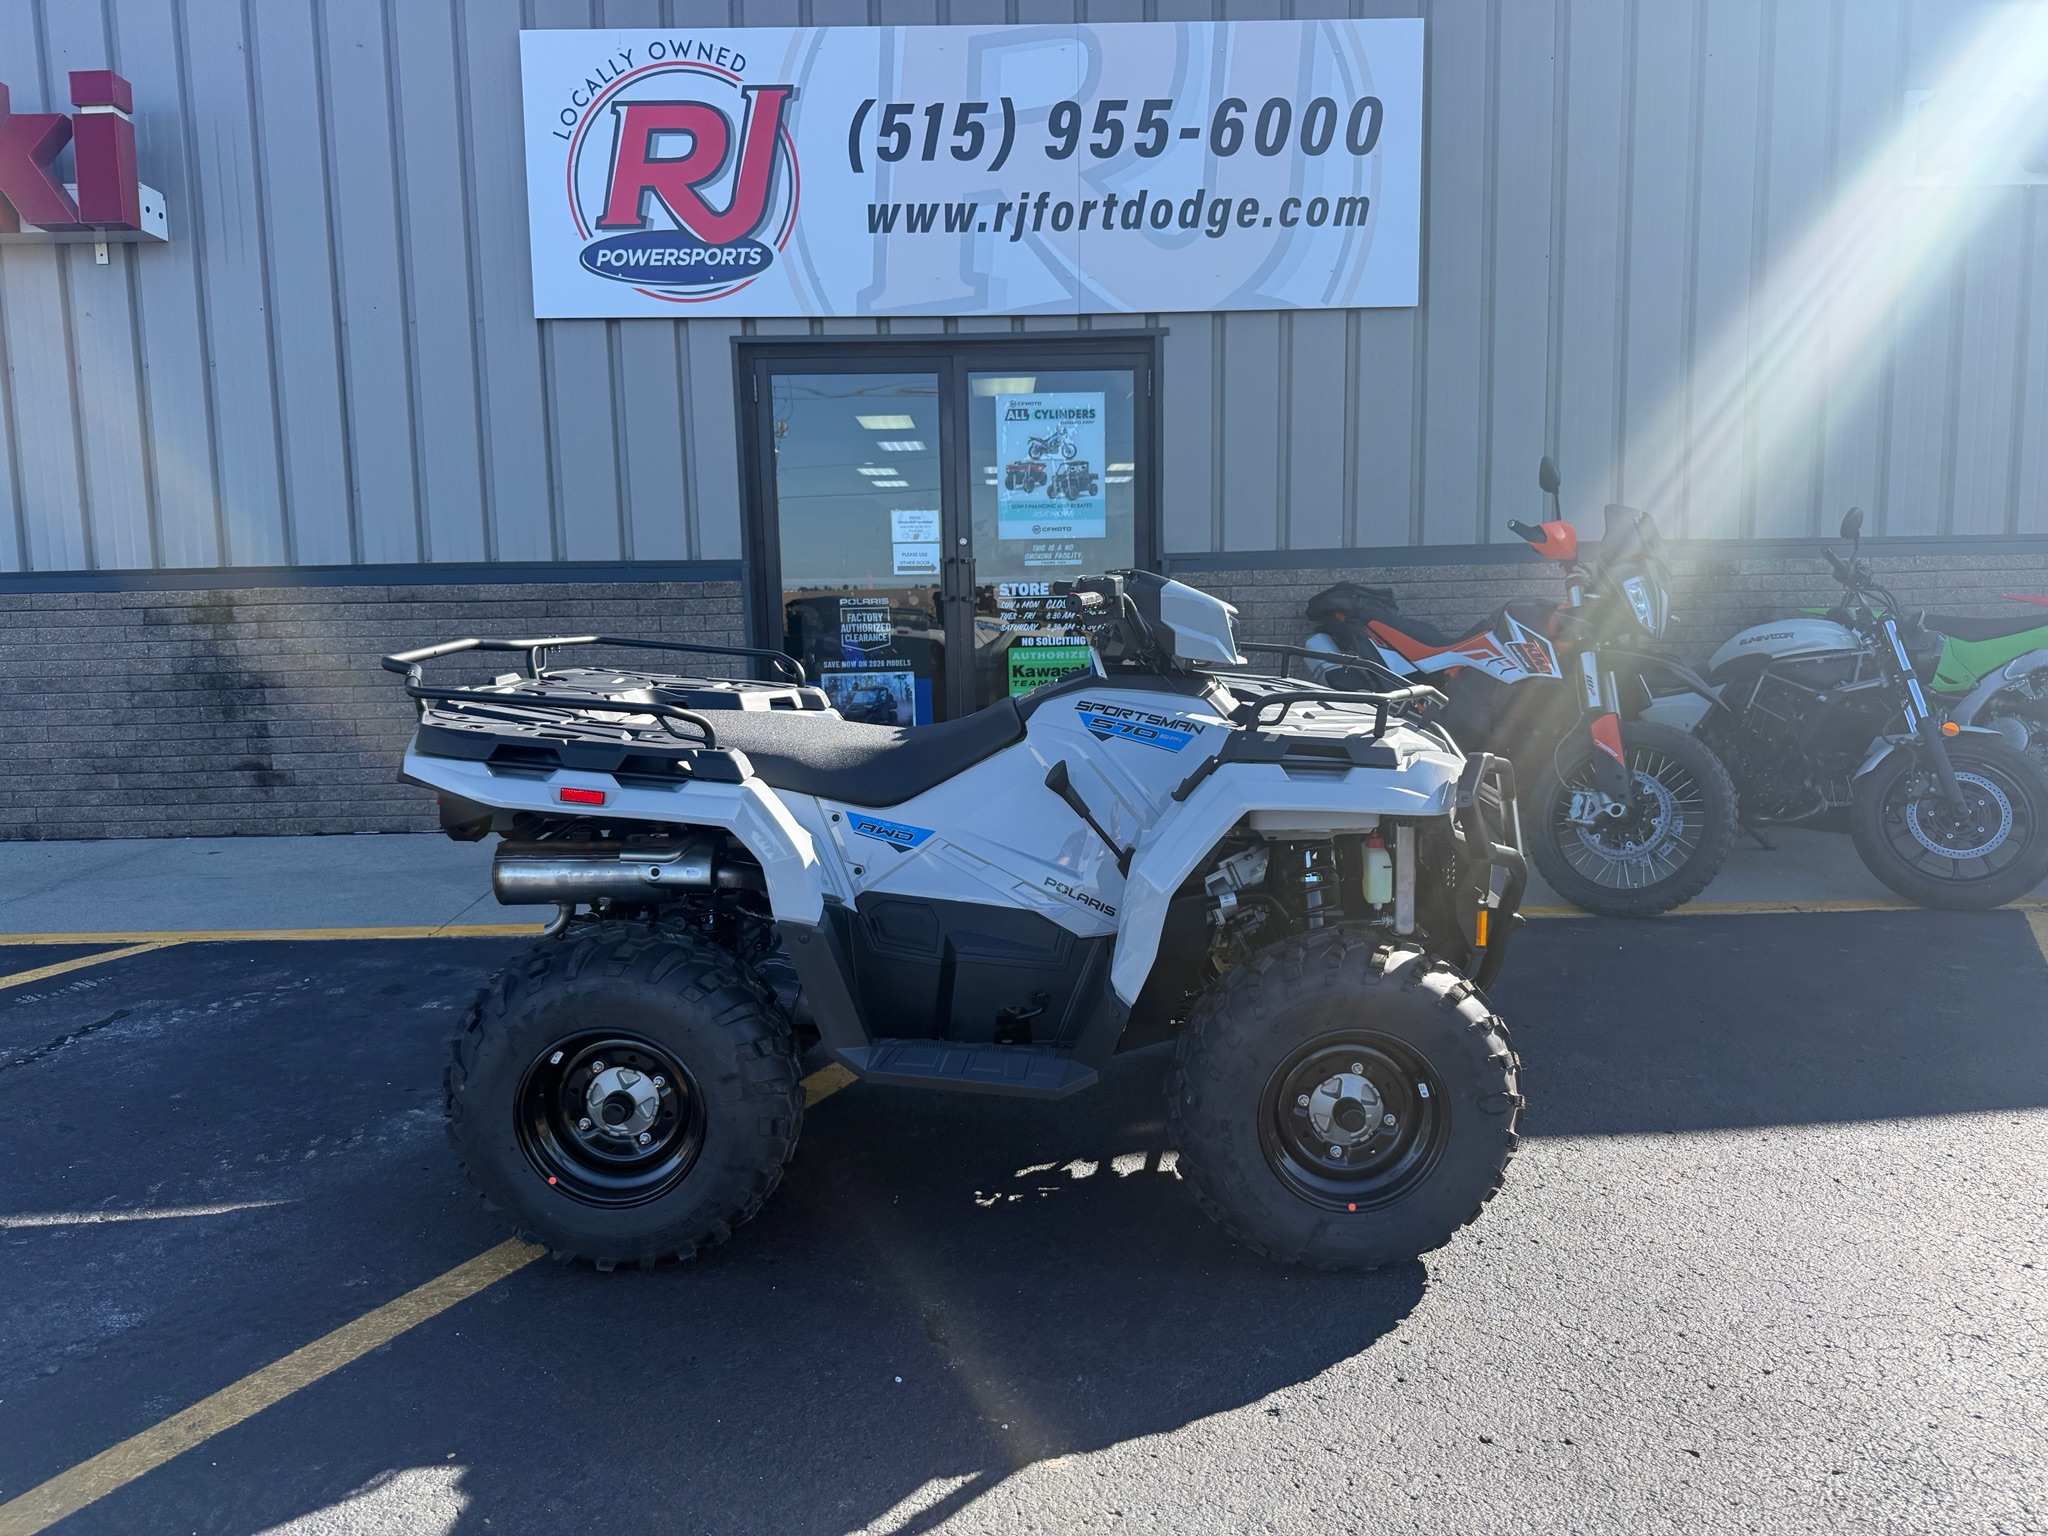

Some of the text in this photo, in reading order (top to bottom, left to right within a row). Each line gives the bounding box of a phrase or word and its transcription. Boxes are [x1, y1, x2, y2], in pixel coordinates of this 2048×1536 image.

[552, 39, 746, 141] LOCALLY OWNED
[848, 96, 1384, 173] (515) 955-6000
[595, 84, 800, 246] RJ
[867, 189, 1370, 242] www.rjfortdodge.com
[596, 247, 763, 267] POWERSPORTS
[1006, 408, 1096, 420] ALL CYLINDERS
[1048, 544, 1055, 552] IS
[999, 582, 1050, 596] STORE
[1001, 600, 1017, 609] SUN
[1021, 600, 1040, 608] MON
[1045, 599, 1067, 609] CLOS
[847, 613, 883, 622] FACTORY
[1000, 612, 1017, 620] TUES
[1023, 611, 1037, 619] FRI
[1061, 611, 1076, 620] AM
[841, 623, 891, 632] AUTHORIZED
[1000, 623, 1040, 631] SATURDAY
[1062, 622, 1076, 631] AM
[845, 633, 887, 642] CLEARANCE
[1021, 636, 1087, 646] NO SOLICITING
[1738, 632, 1796, 646] ELIMINATOR
[1012, 663, 1086, 678] Kawas
[1074, 700, 1206, 735] SPORTSMAN
[1089, 717, 1158, 739] 570
[856, 822, 915, 842] AWD
[1043, 876, 1117, 917] POLARIS
